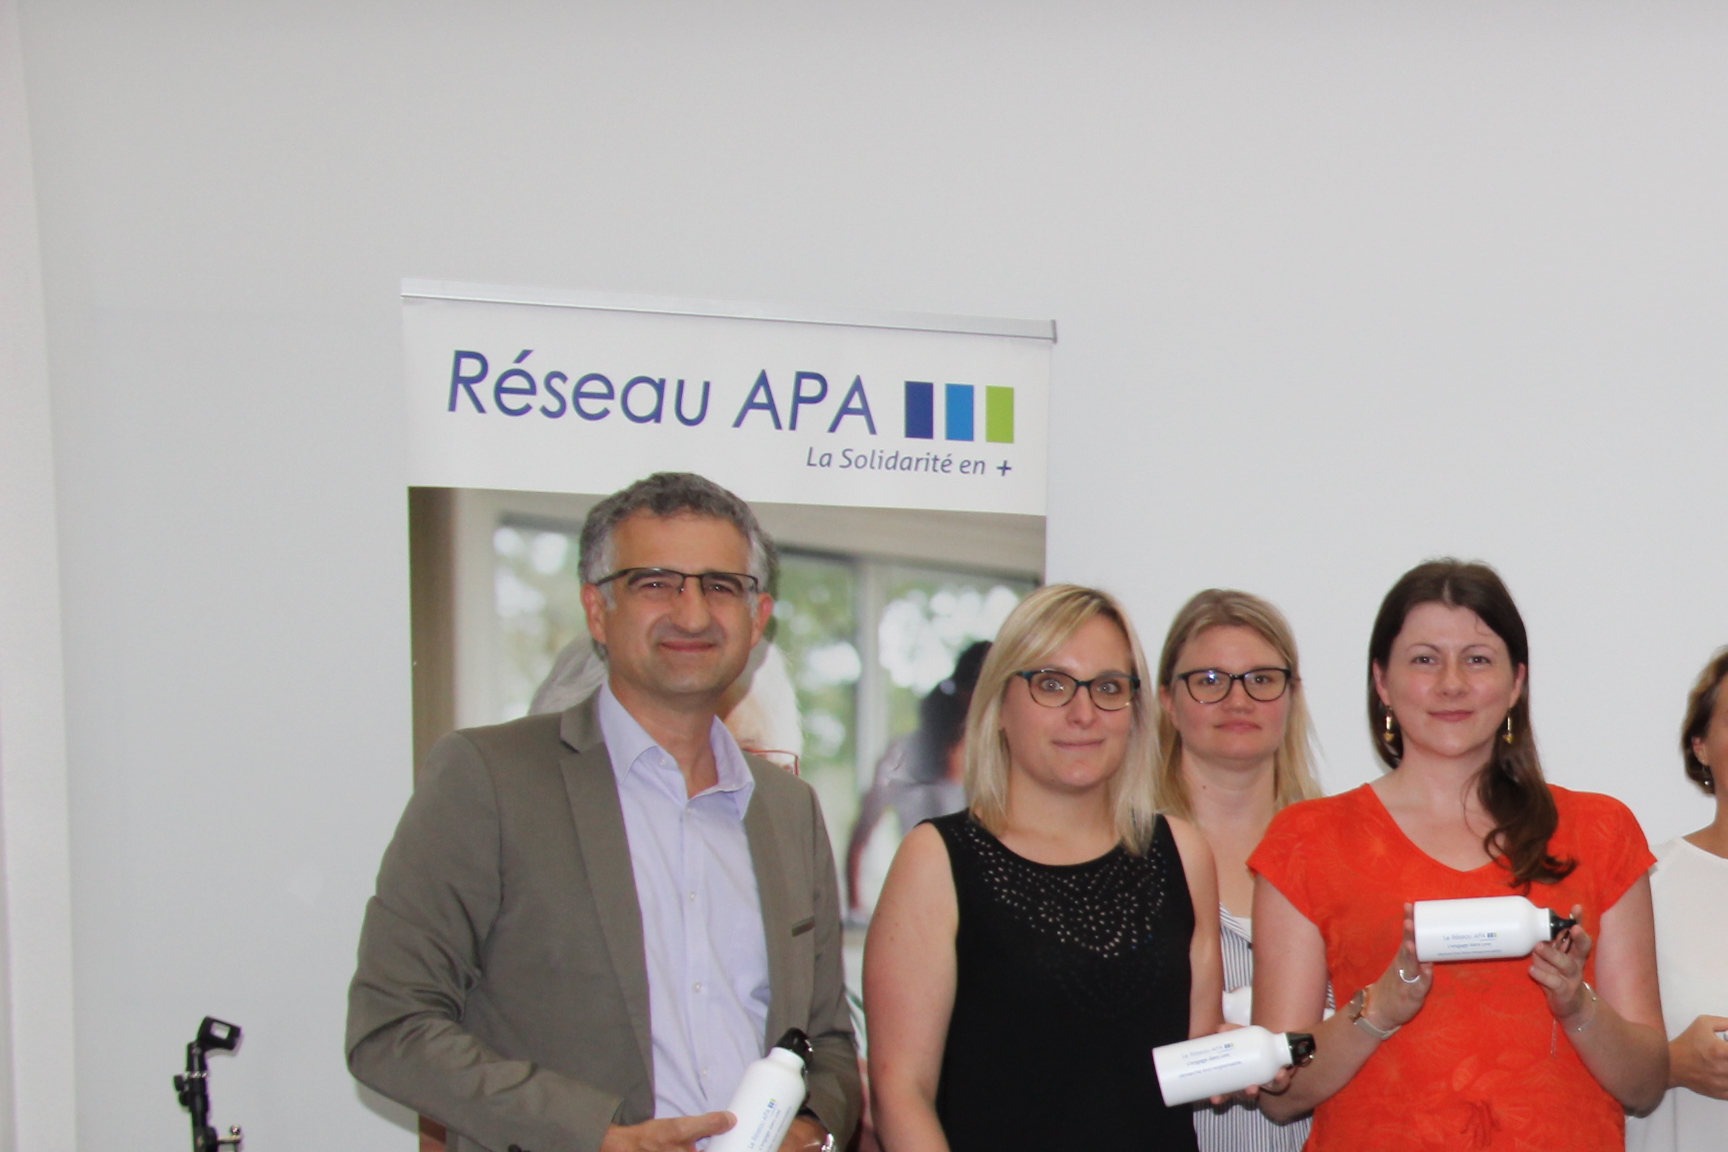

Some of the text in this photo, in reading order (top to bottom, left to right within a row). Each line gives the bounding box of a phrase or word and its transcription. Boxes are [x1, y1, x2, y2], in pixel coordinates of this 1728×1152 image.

[447, 349, 877, 435] Réseau APA
[806, 447, 832, 468] La
[839, 448, 952, 473] Solidarité
[959, 459, 986, 475] en
